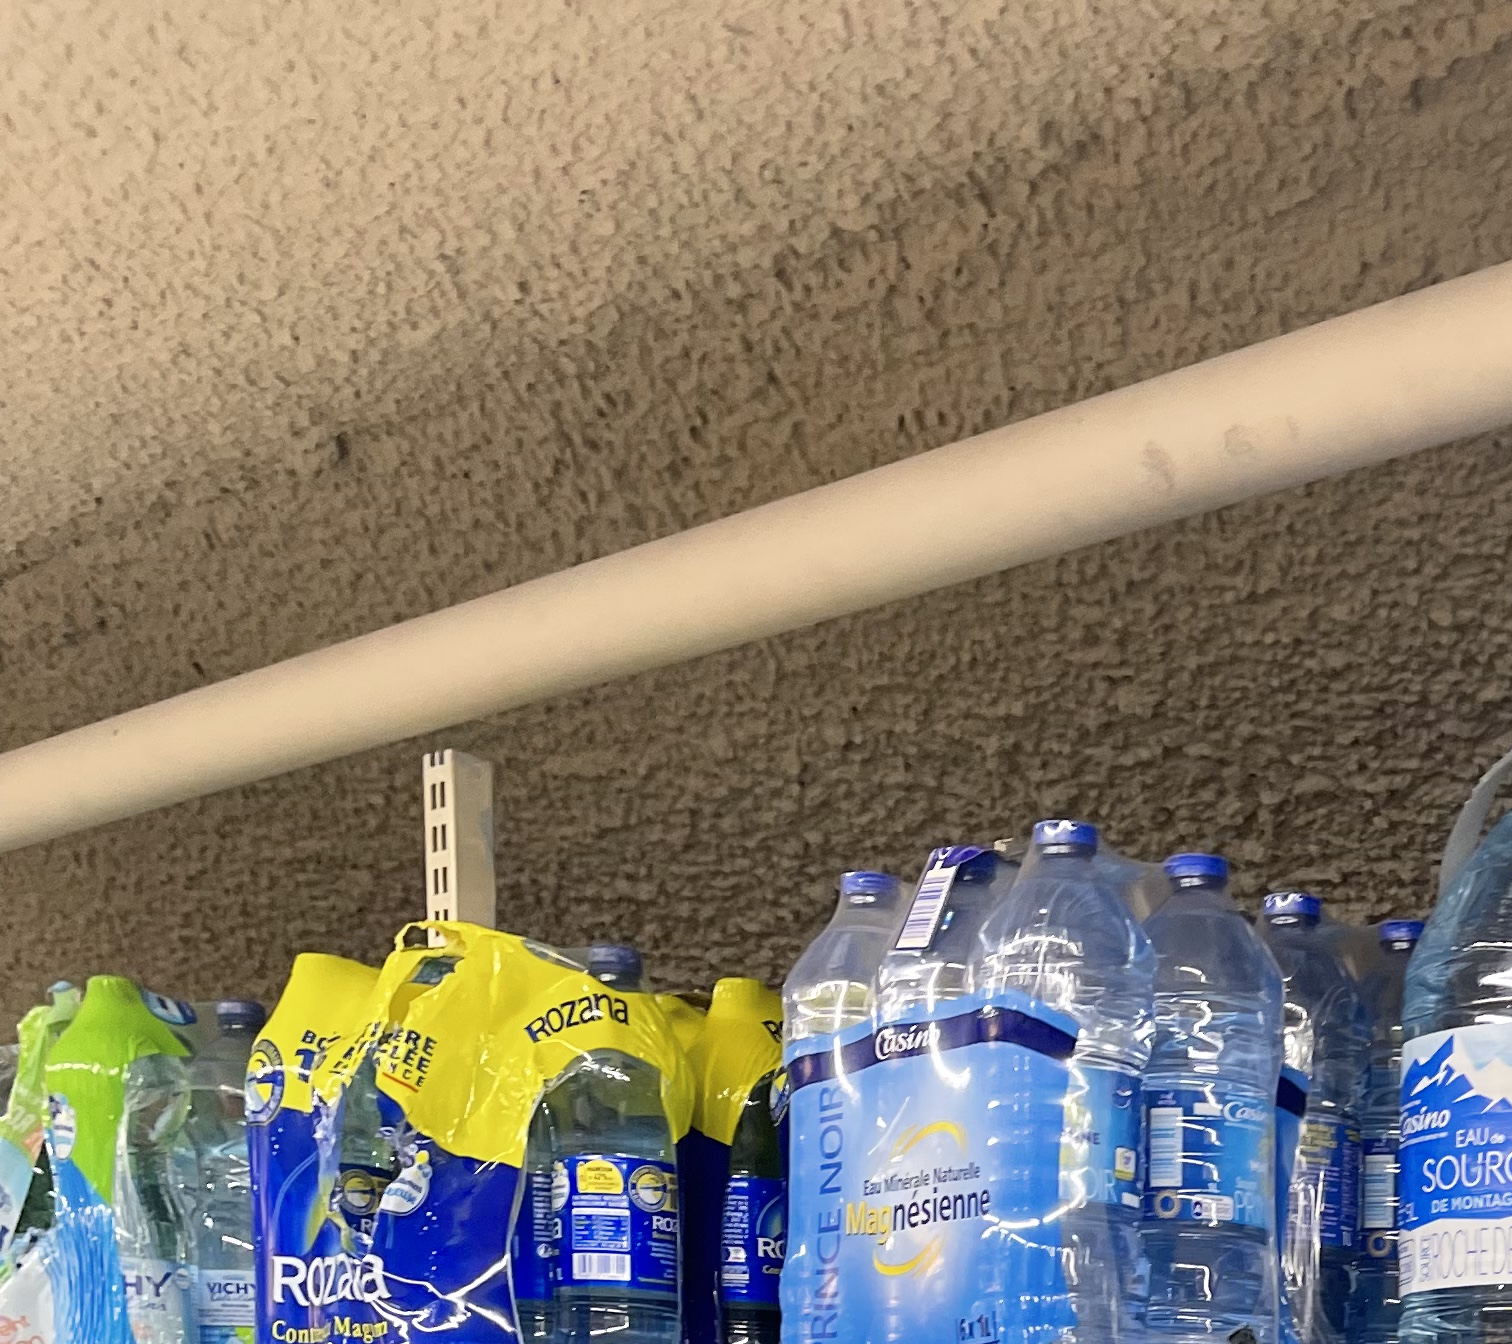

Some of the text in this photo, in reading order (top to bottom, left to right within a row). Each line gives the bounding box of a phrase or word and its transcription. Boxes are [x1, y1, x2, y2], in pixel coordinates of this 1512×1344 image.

[874, 1023, 941, 1060] Casino
[817, 1086, 844, 1204] NOIR
[1455, 1127, 1488, 1149] EAU
[863, 1177, 882, 1199] Eau
[846, 1182, 991, 1247] Magnésienne
[1431, 1197, 1449, 1214] DE
